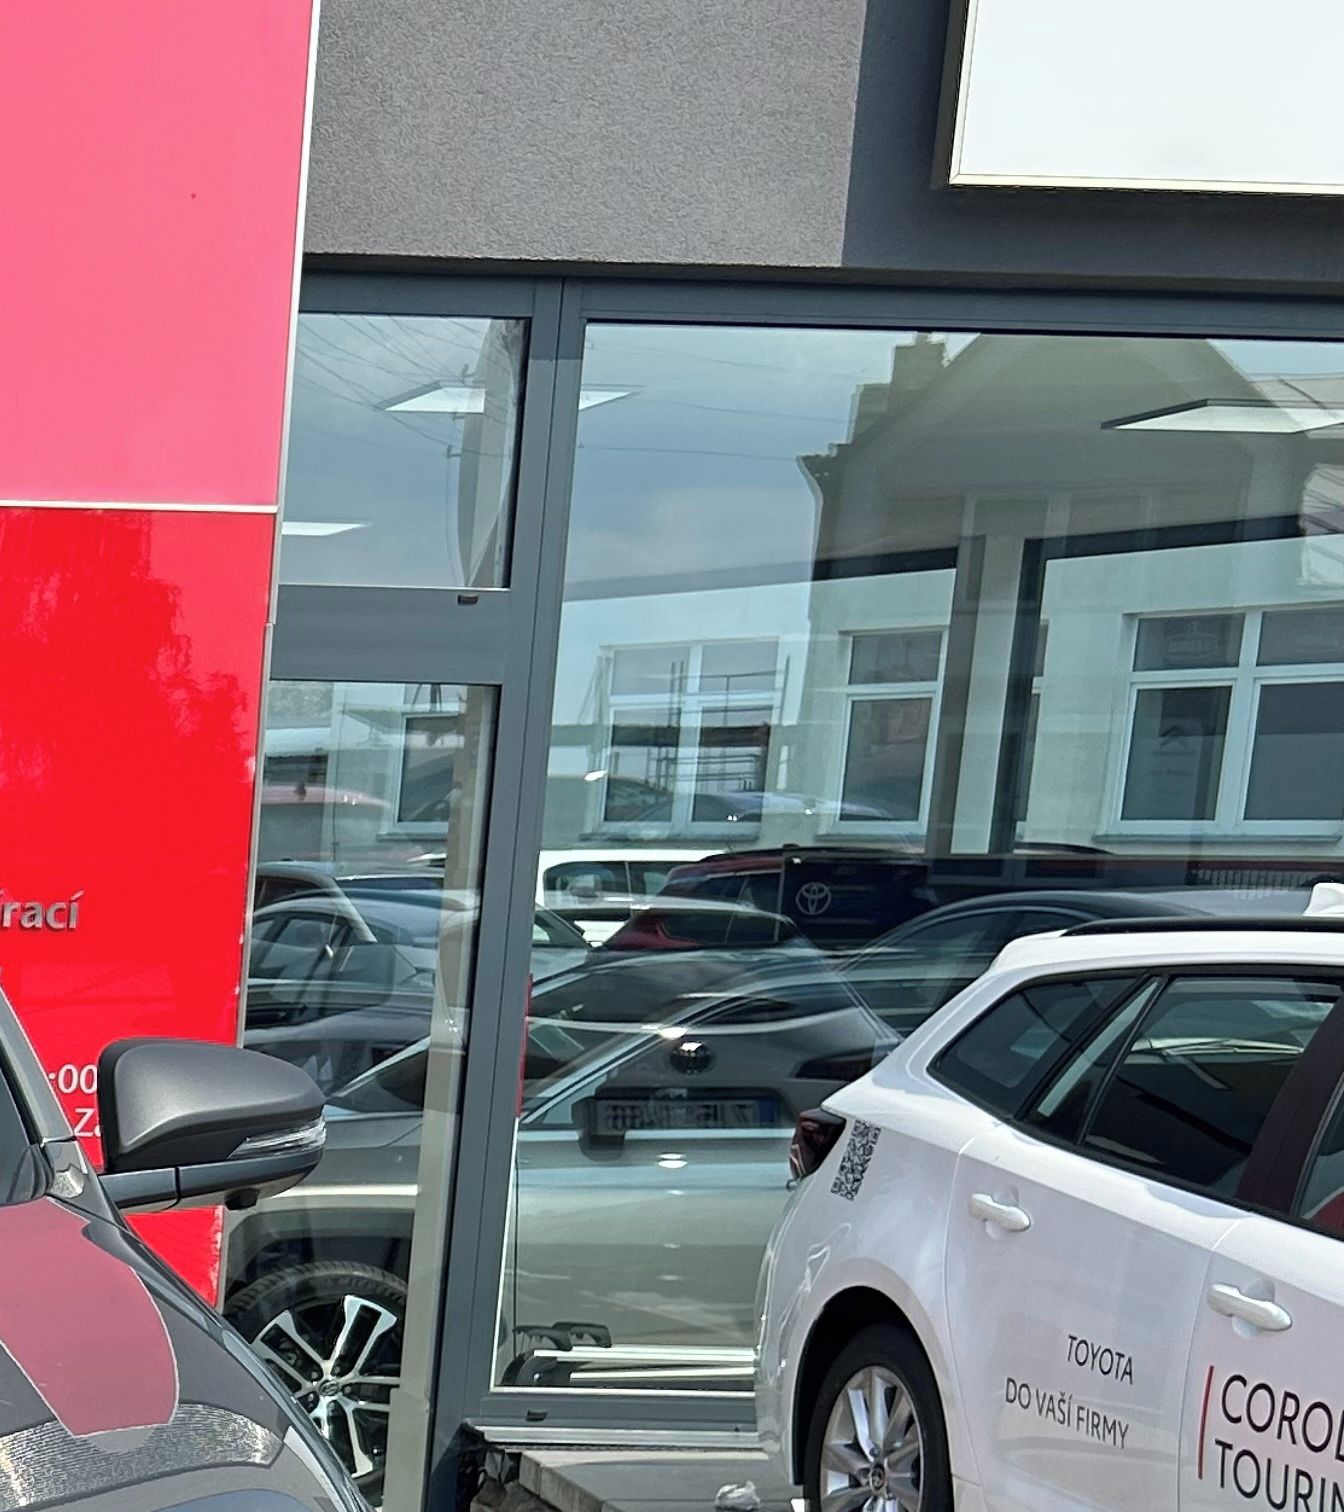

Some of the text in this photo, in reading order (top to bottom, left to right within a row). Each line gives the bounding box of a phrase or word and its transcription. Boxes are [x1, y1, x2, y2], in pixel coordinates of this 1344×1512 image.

[1067, 1334, 1134, 1385] TOYOTA
[1005, 1377, 1130, 1449] DO VAŠÍ FIRMY
